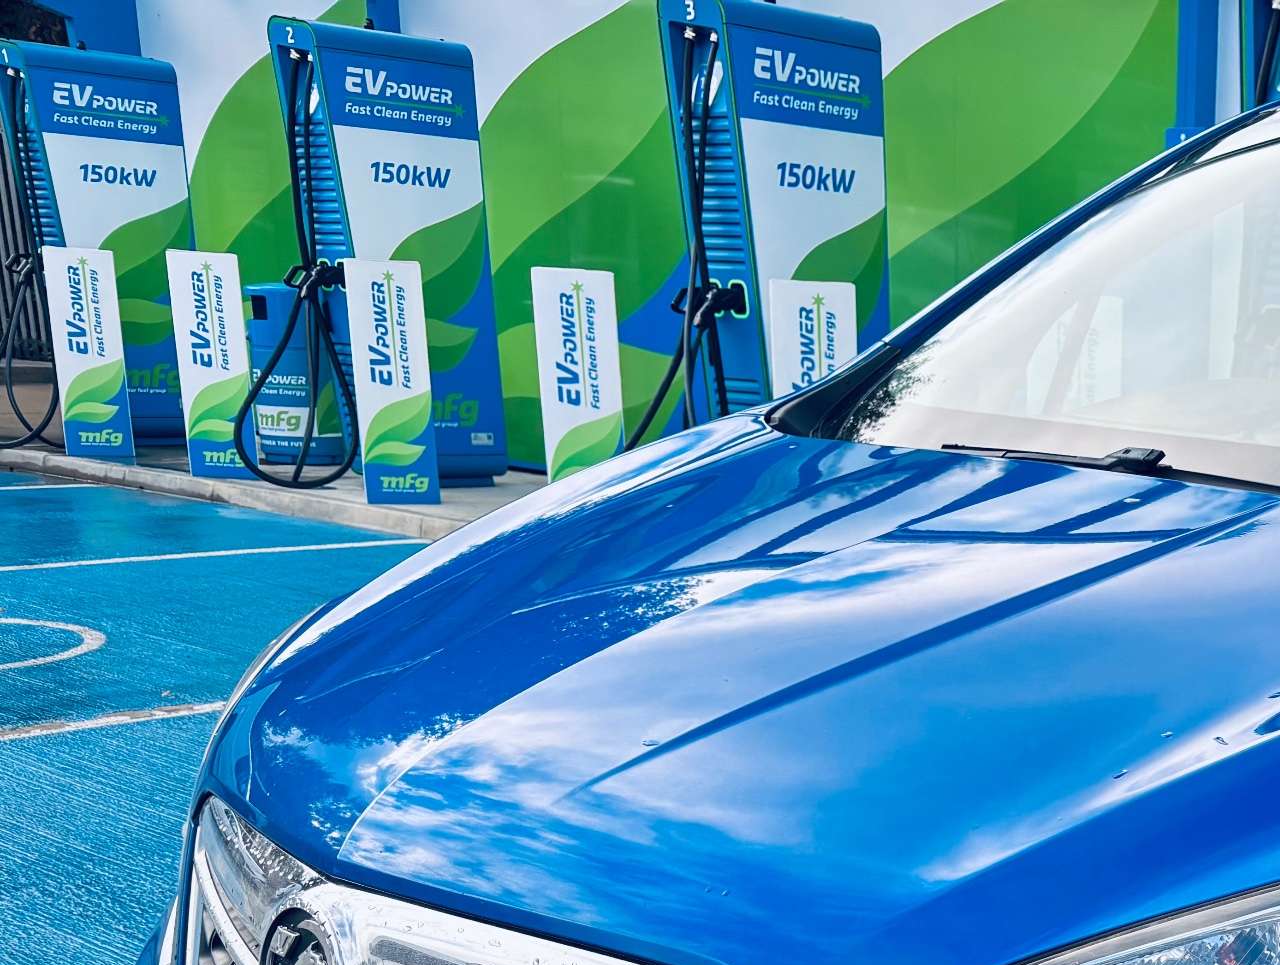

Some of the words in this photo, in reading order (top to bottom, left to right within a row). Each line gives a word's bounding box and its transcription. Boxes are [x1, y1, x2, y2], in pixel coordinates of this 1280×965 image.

[685, 0, 696, 21] 3
[285, 26, 295, 44] 2
[2, 49, 8, 63] 1
[345, 102, 372, 116] Fast
[374, 105, 408, 120] Clean
[410, 110, 453, 127] Energy
[753, 90, 780, 107] Fast
[781, 95, 816, 112] Clean
[818, 101, 860, 121] Energy
[53, 113, 80, 125] Fast
[81, 116, 114, 128] Clean
[117, 119, 157, 134] Energy
[79, 163, 157, 187] 150kW
[370, 161, 452, 189] 150kW
[777, 162, 856, 194] 150kW
[89, 269, 101, 305] Energy
[214, 275, 225, 311] Energy
[395, 286, 408, 327] Energy
[585, 297, 596, 342] Energy
[93, 306, 103, 335] Clean
[217, 312, 228, 345] Clean
[96, 336, 106, 358] Fast
[398, 328, 410, 363] Clean
[824, 311, 836, 360] Energy
[220, 346, 230, 371] Fast
[588, 345, 600, 381] Clean
[401, 364, 412, 389] Fast
[279, 388, 306, 397] Energy
[590, 383, 600, 410] Fast
[259, 410, 301, 431] mfg
[78, 429, 123, 447] mfg
[379, 473, 430, 493] mfg
